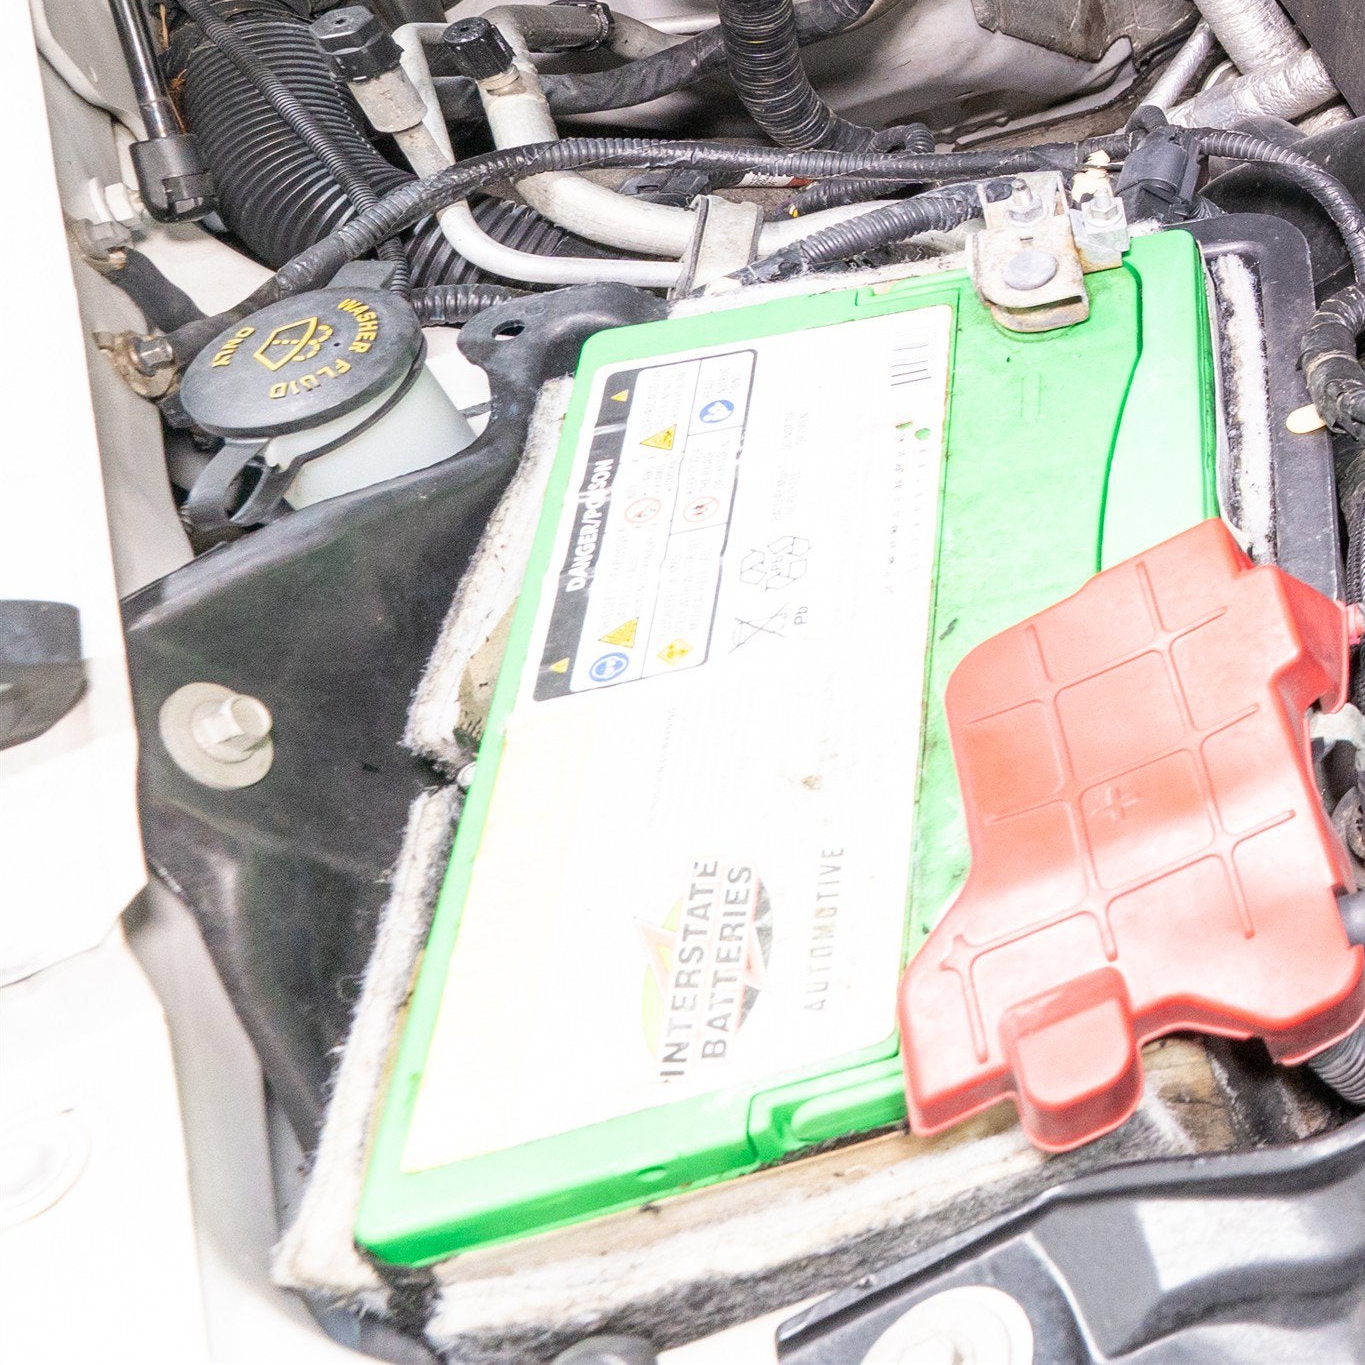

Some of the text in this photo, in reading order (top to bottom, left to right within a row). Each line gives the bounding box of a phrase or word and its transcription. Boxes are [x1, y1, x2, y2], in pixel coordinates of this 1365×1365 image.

[211, 327, 255, 368] ONLY
[269, 298, 379, 399] WASHER FLUID
[793, 604, 808, 626] Pb
[660, 862, 717, 1074] INTERSTATE
[700, 867, 752, 1056] BATTERIES
[802, 849, 844, 1010] AUTOMOTIVE
